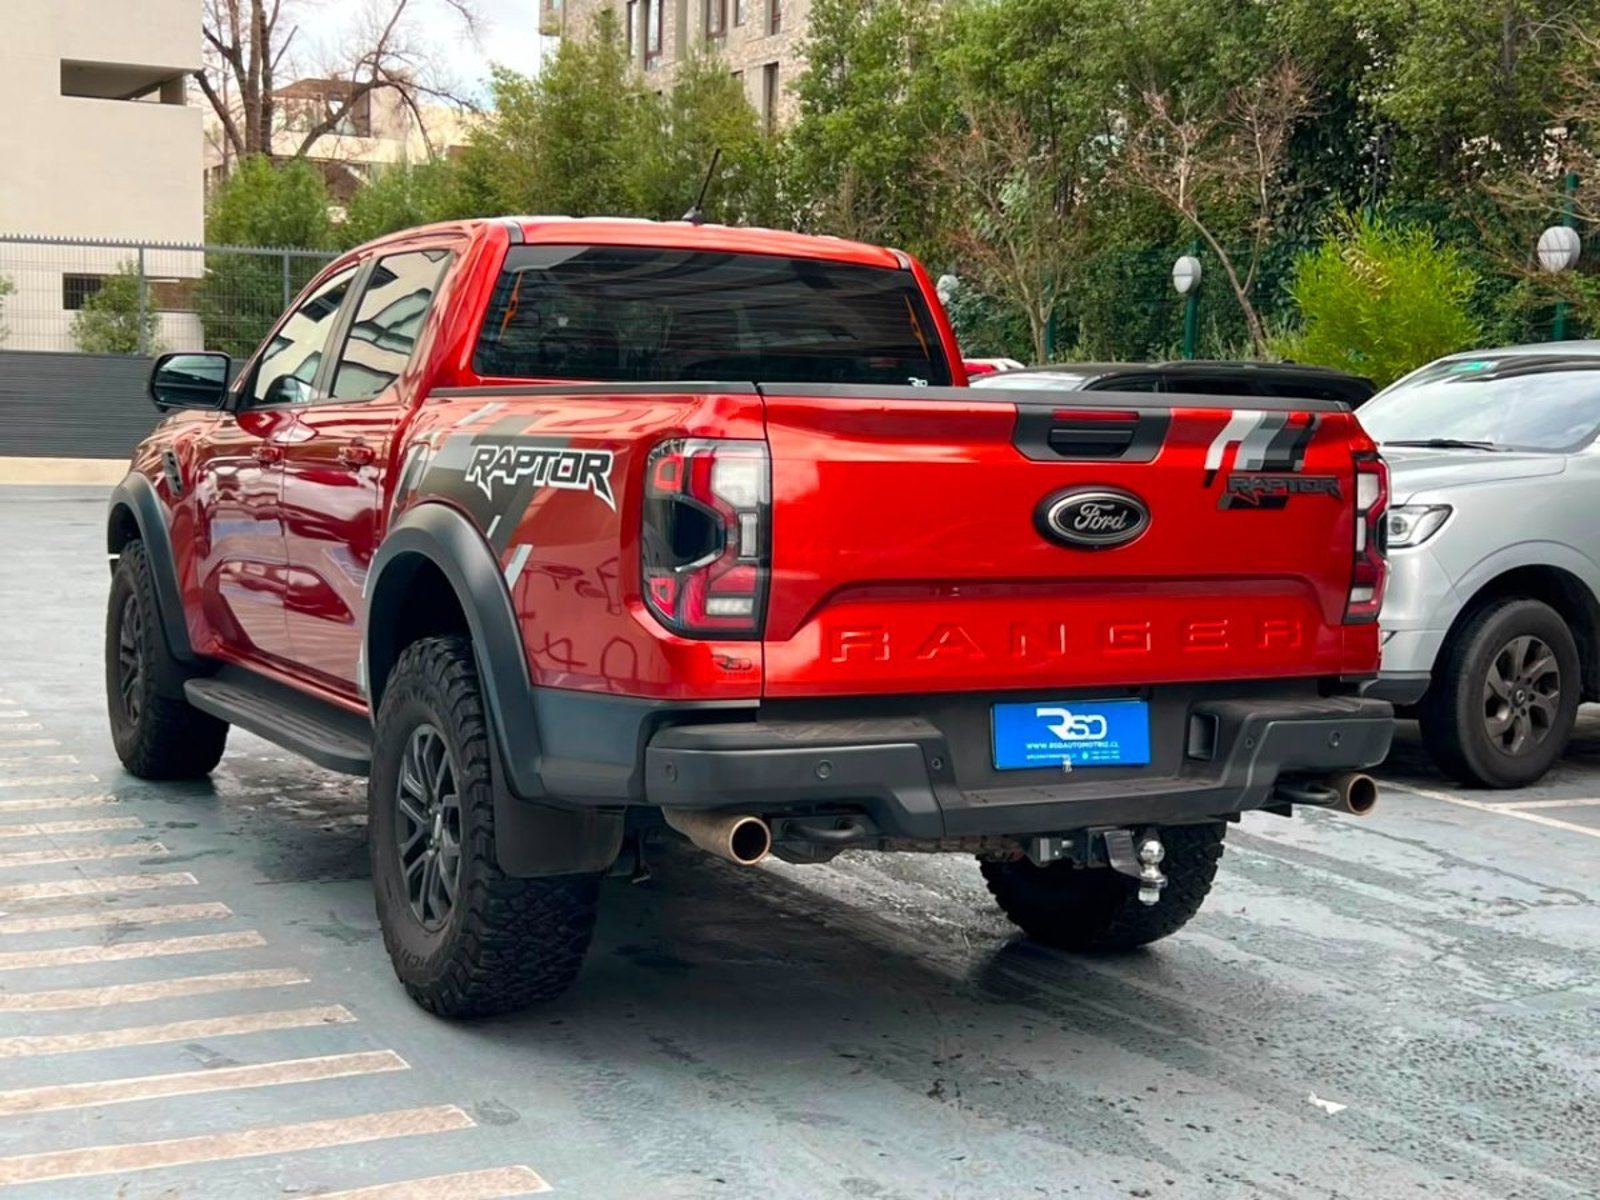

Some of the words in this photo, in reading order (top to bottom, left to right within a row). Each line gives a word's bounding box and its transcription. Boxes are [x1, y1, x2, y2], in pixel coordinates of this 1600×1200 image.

[464, 445, 617, 513] RAPTOR
[1226, 473, 1344, 507] RAPTOR
[1073, 502, 1128, 530] Ford
[826, 617, 1302, 664] RANGER
[1036, 707, 1108, 741] RSD
